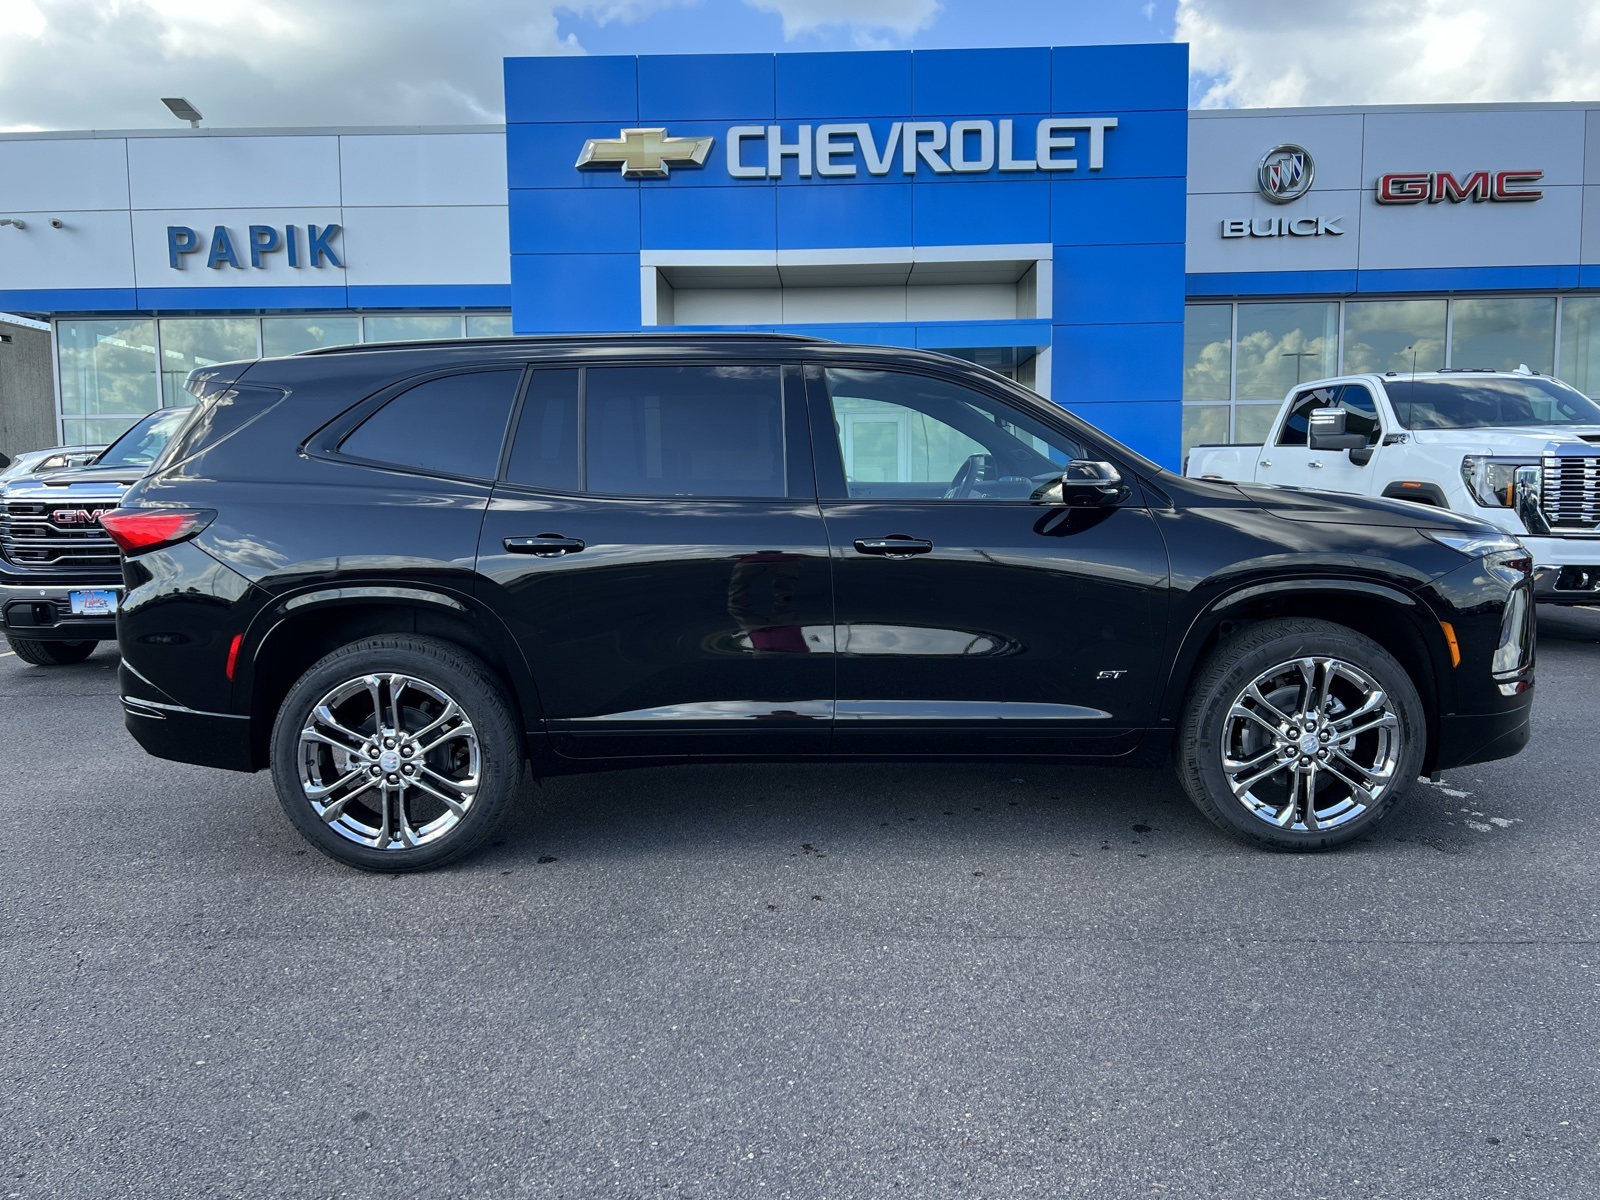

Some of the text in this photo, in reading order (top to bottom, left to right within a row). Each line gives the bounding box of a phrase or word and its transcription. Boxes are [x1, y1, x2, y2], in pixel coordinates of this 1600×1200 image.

[726, 117, 1118, 179] CHEVROLET
[1376, 169, 1544, 205] GMC
[167, 224, 346, 270] PAPIK
[1221, 215, 1345, 239] BUICK
